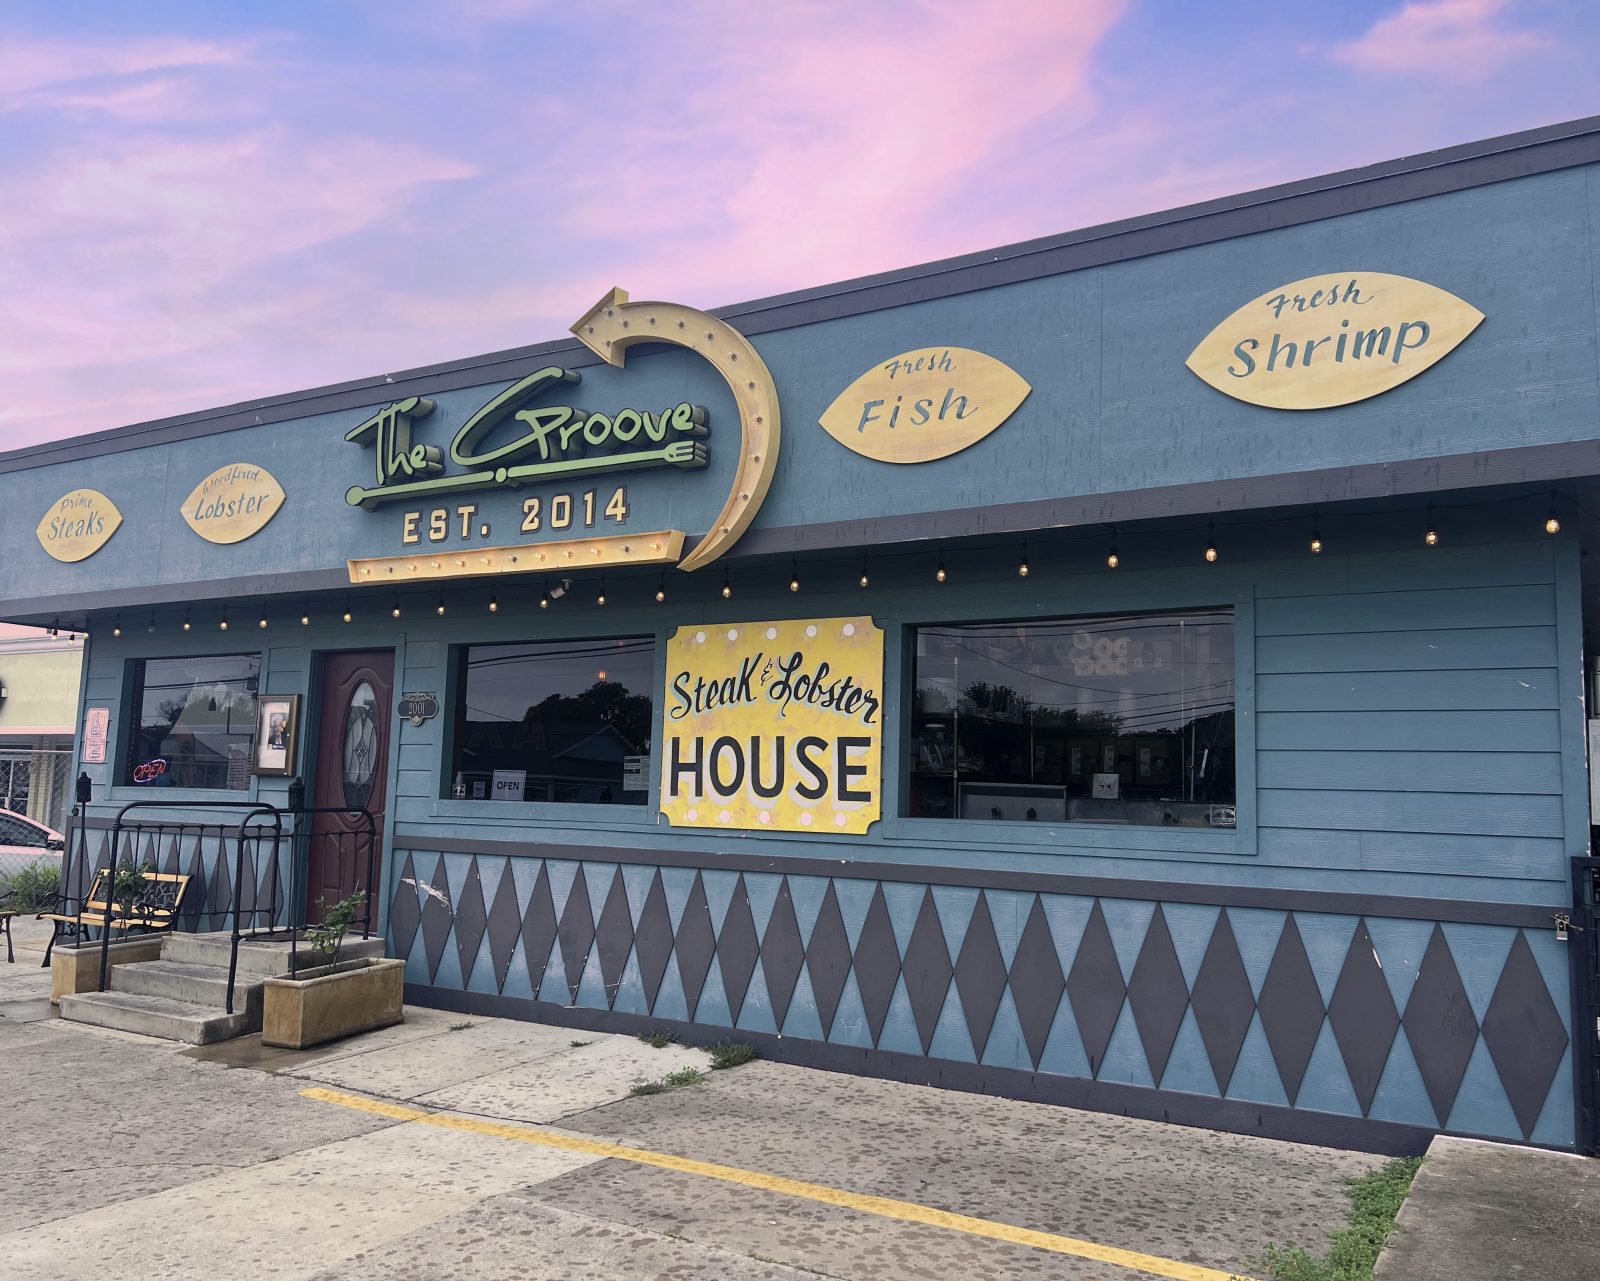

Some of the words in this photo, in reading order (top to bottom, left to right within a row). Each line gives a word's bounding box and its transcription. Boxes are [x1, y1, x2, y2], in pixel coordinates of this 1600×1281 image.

[1265, 279, 1375, 320] Fresh
[884, 350, 957, 380] Fresh
[1227, 319, 1431, 378] Shrimp
[344, 396, 437, 486] The
[449, 366, 704, 467] Groove
[857, 387, 980, 433] Fish
[194, 492, 270, 521] Lobster
[402, 505, 492, 544] EST.
[520, 487, 629, 534] 2014
[408, 702, 425, 715] 2001
[760, 657, 774, 687] &
[768, 651, 880, 724] Lobster
[134, 761, 166, 780] OPEN
[496, 781, 520, 791] OPEN
[669, 735, 872, 803] HOUSE
